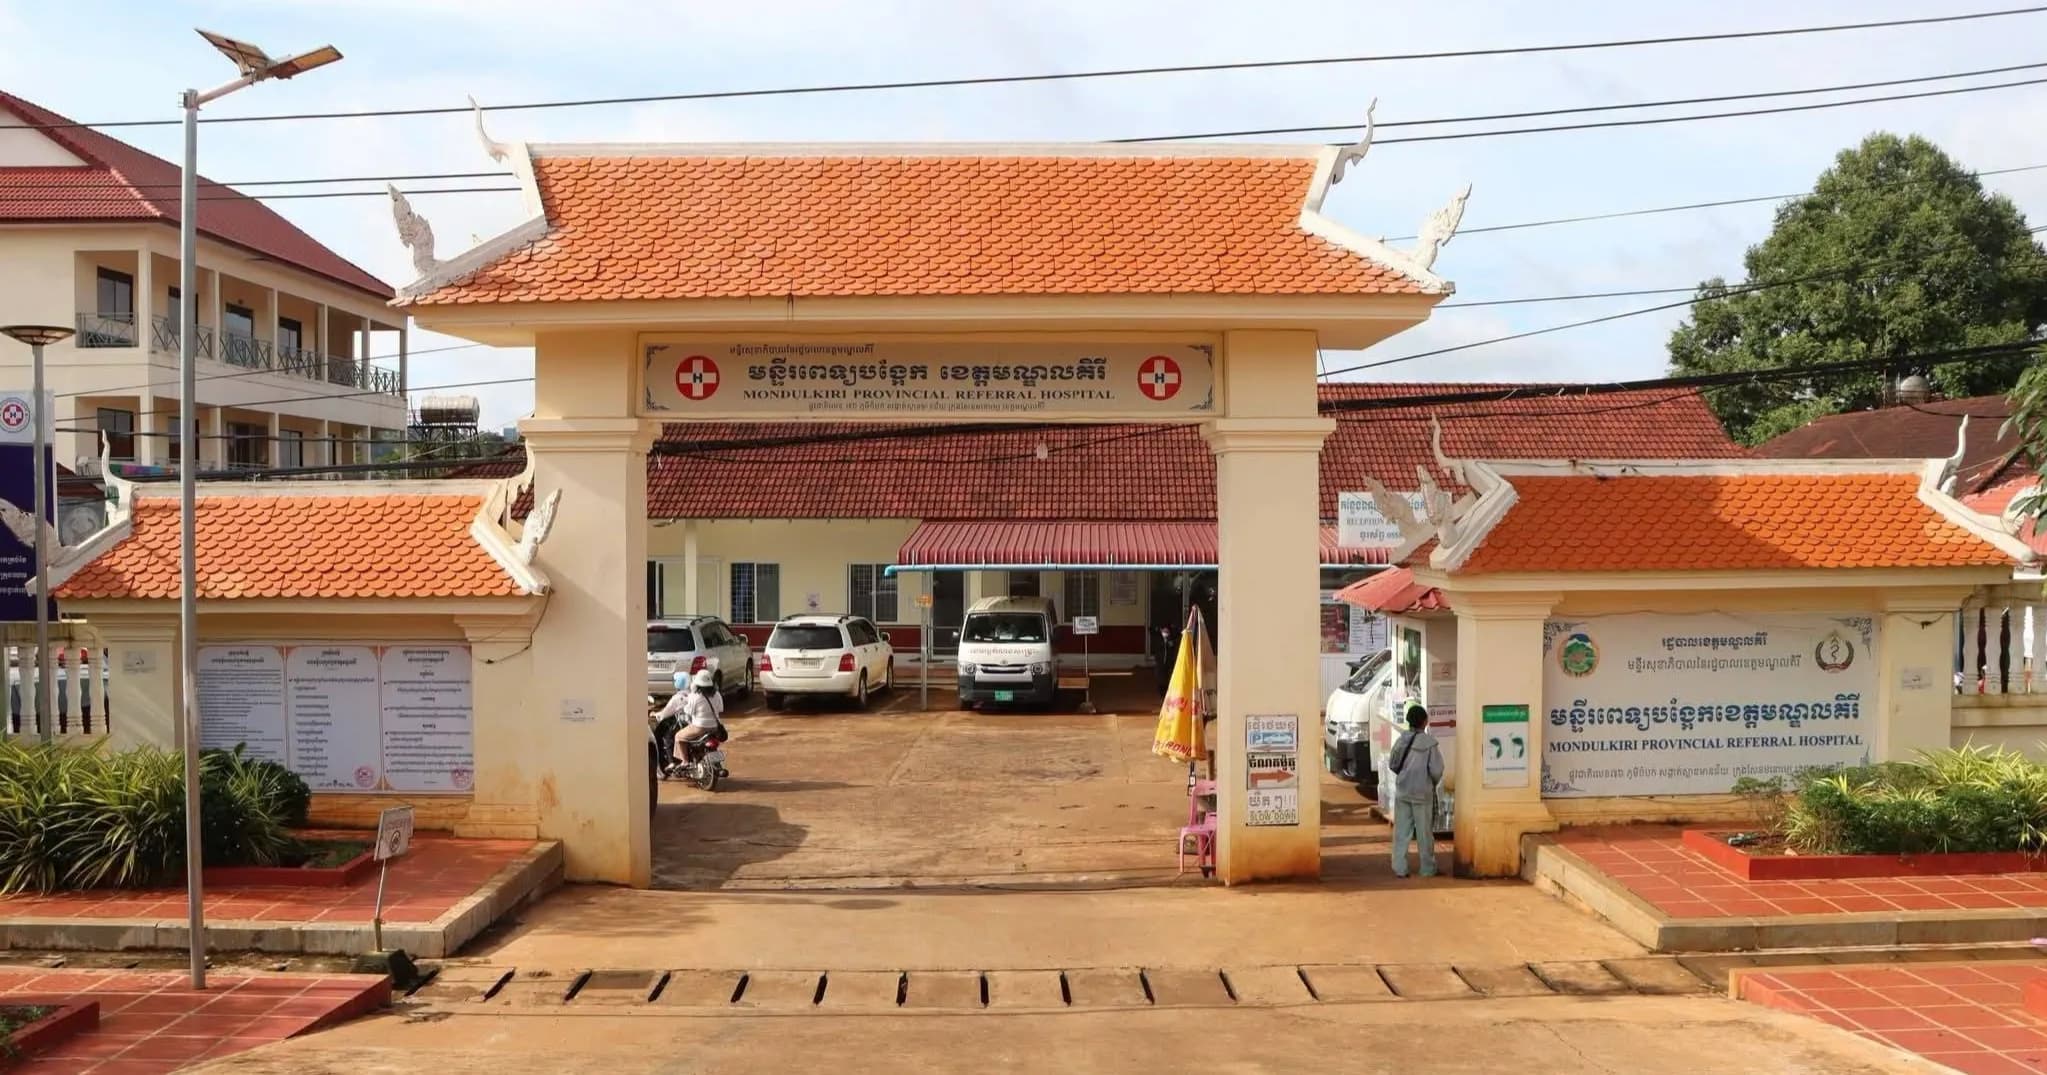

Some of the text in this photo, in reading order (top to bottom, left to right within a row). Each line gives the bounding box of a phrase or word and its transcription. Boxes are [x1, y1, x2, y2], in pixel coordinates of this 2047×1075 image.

[692, 373, 703, 383] H
[1154, 373, 1165, 383] H
[743, 389, 1116, 400] MONDULKIRI PROVINCIAL REFERRAL HOSPITAL
[1549, 734, 1864, 753] MONDULKIRI PROVINCIAL REFERRAL HOSPITAL
